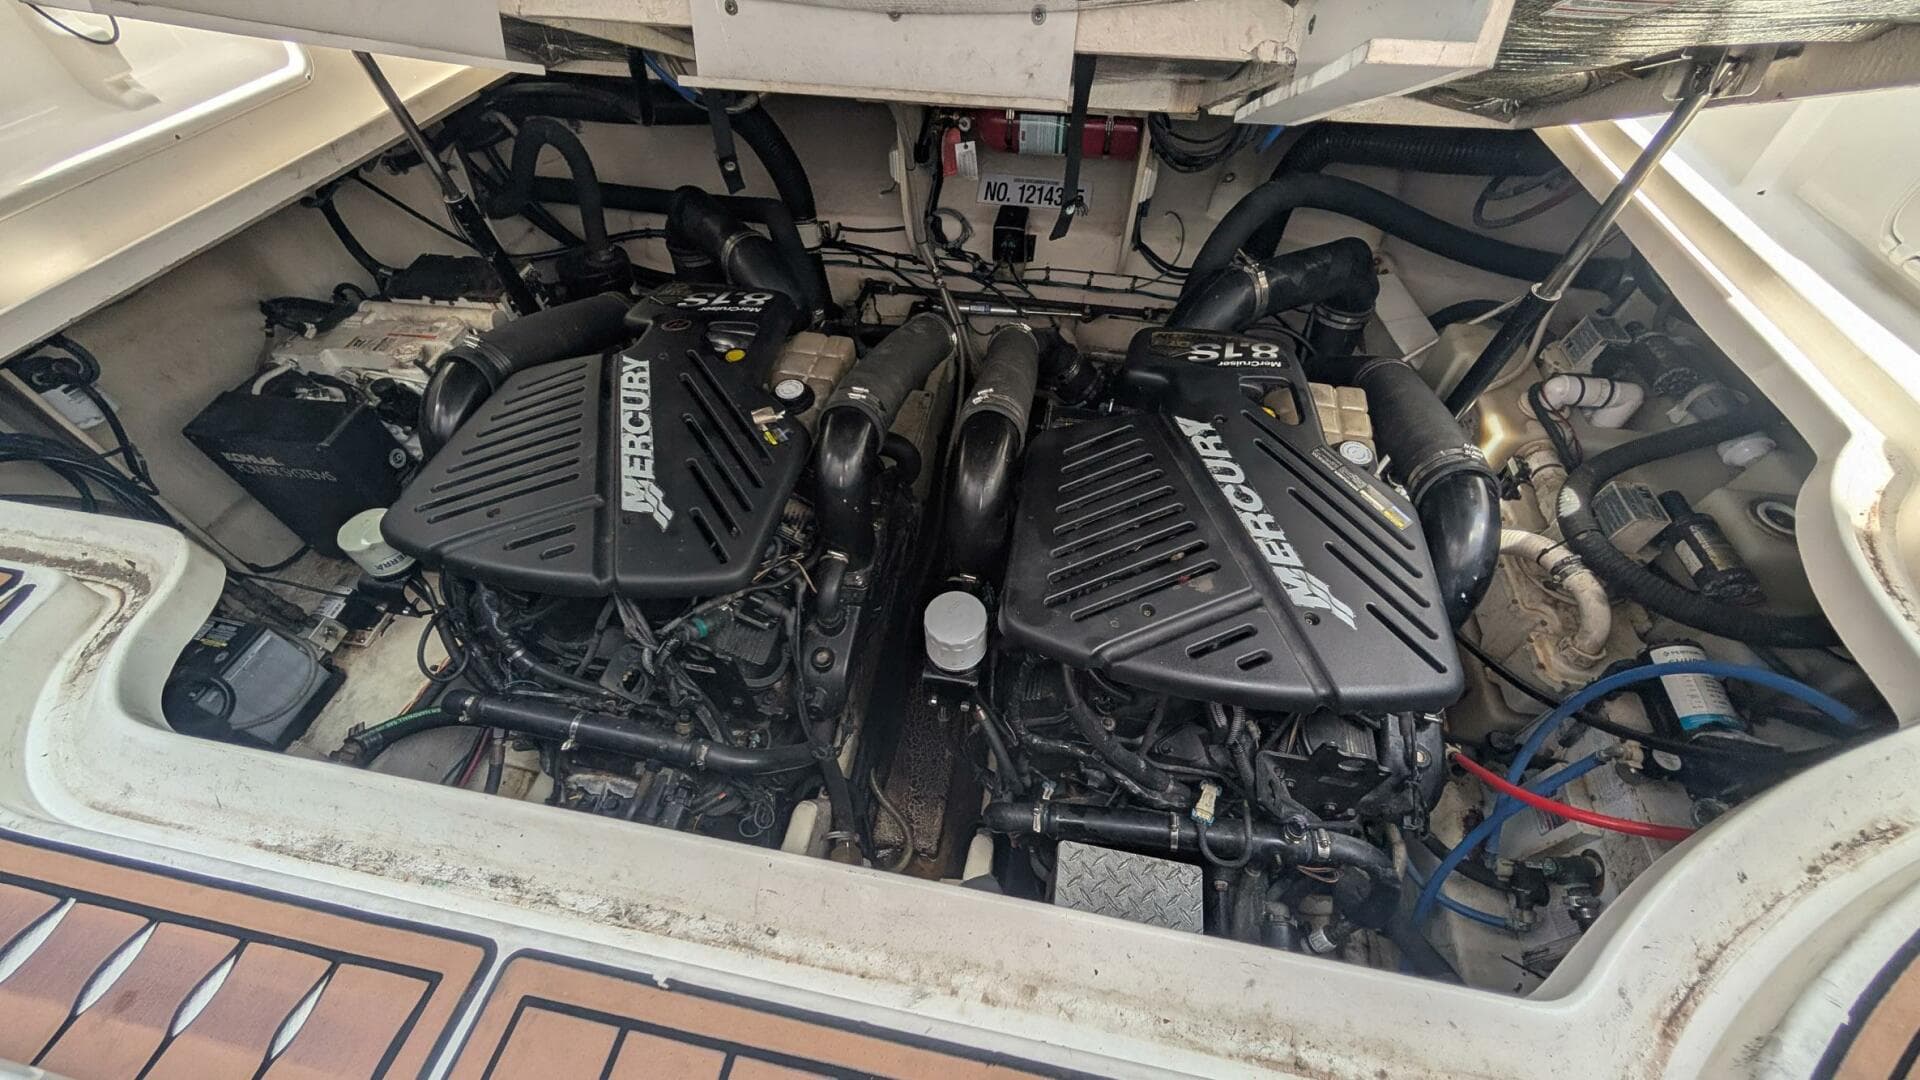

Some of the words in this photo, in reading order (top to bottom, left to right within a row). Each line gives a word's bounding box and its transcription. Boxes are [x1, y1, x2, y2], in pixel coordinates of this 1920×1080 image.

[983, 181, 1010, 202] NO.
[1018, 184, 1084, 207] 121435
[677, 292, 773, 307] 8.1S
[1187, 342, 1280, 362] 8.1S
[1217, 360, 1282, 368] MerCruiser
[621, 354, 673, 532] MERCURY
[1175, 416, 1357, 630] MERCURY
